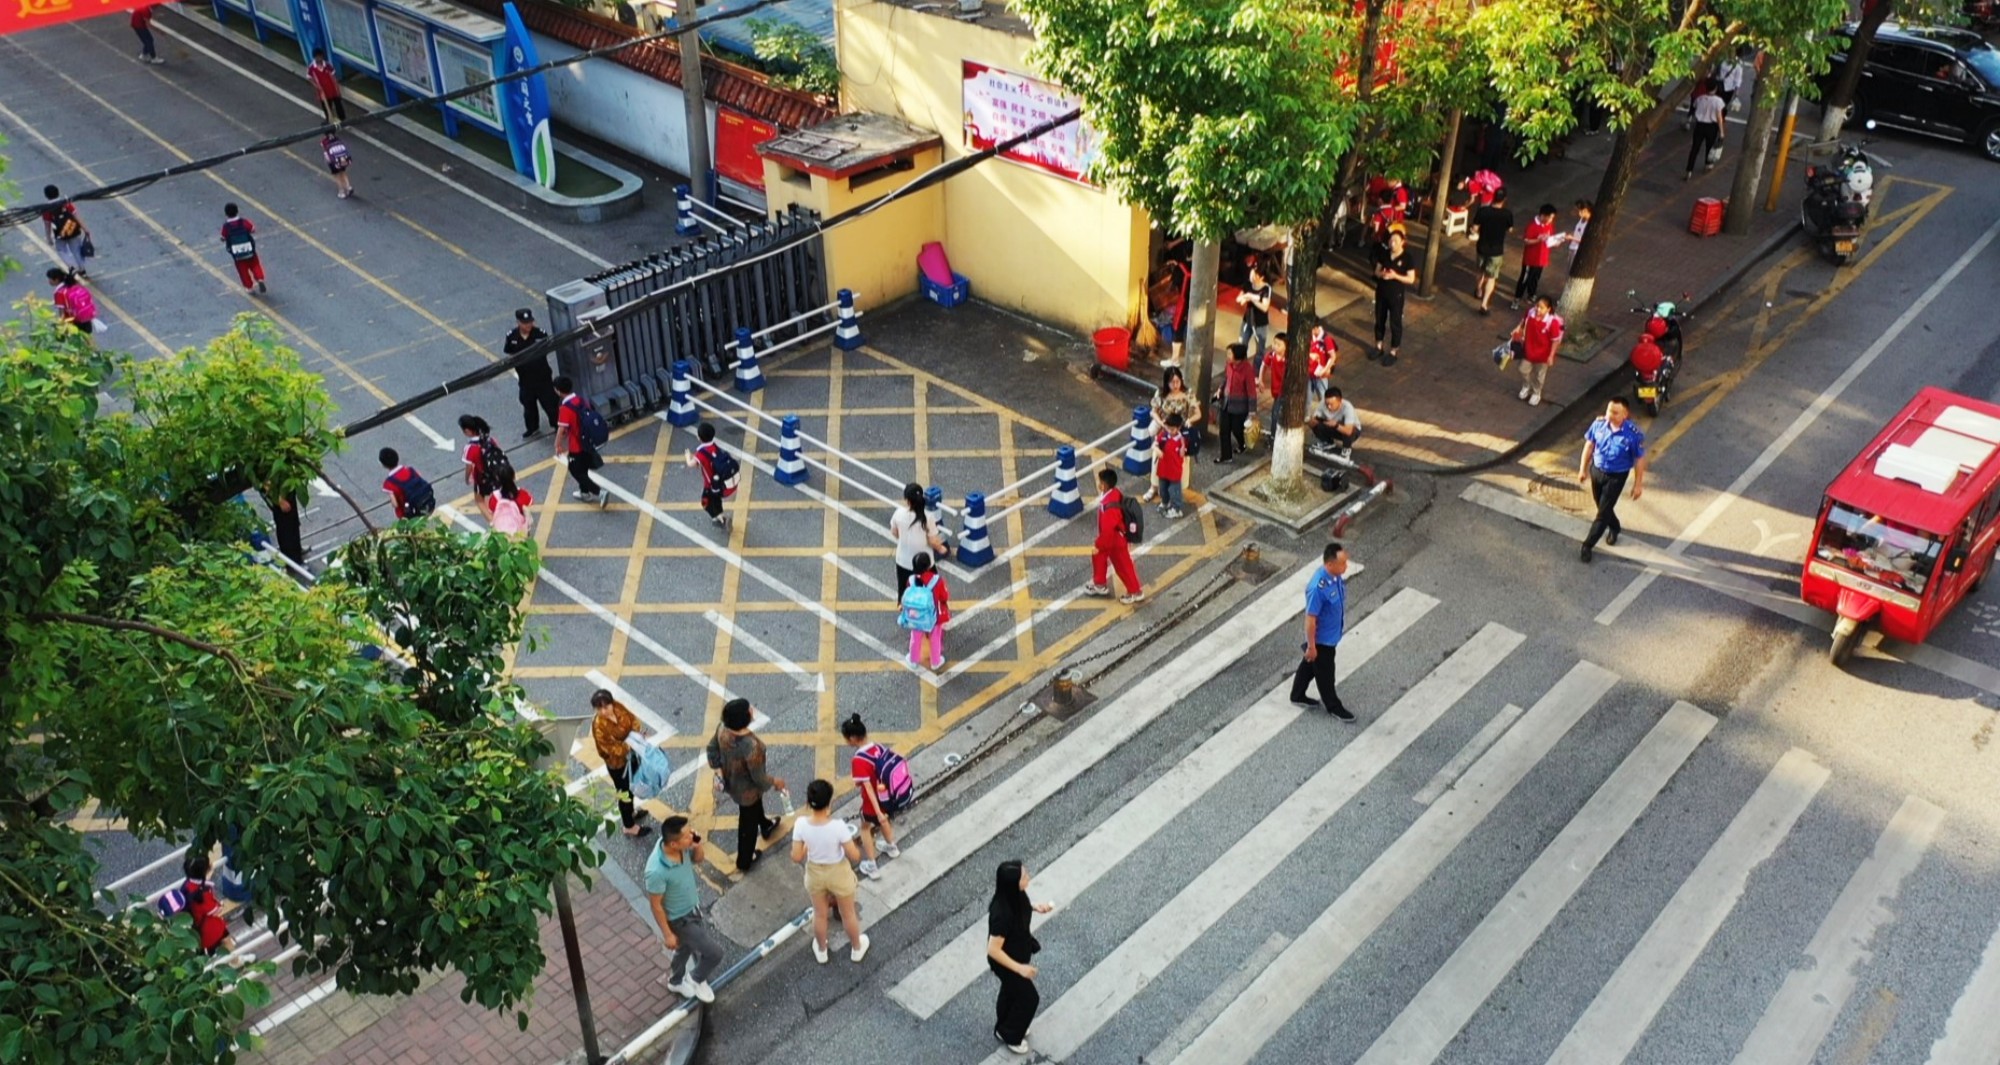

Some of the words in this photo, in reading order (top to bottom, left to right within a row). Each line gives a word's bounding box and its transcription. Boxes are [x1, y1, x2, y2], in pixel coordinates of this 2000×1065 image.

[992, 98, 1007, 110] 富强
[1011, 103, 1026, 115] 民主
[1031, 109, 1046, 120] 文明
